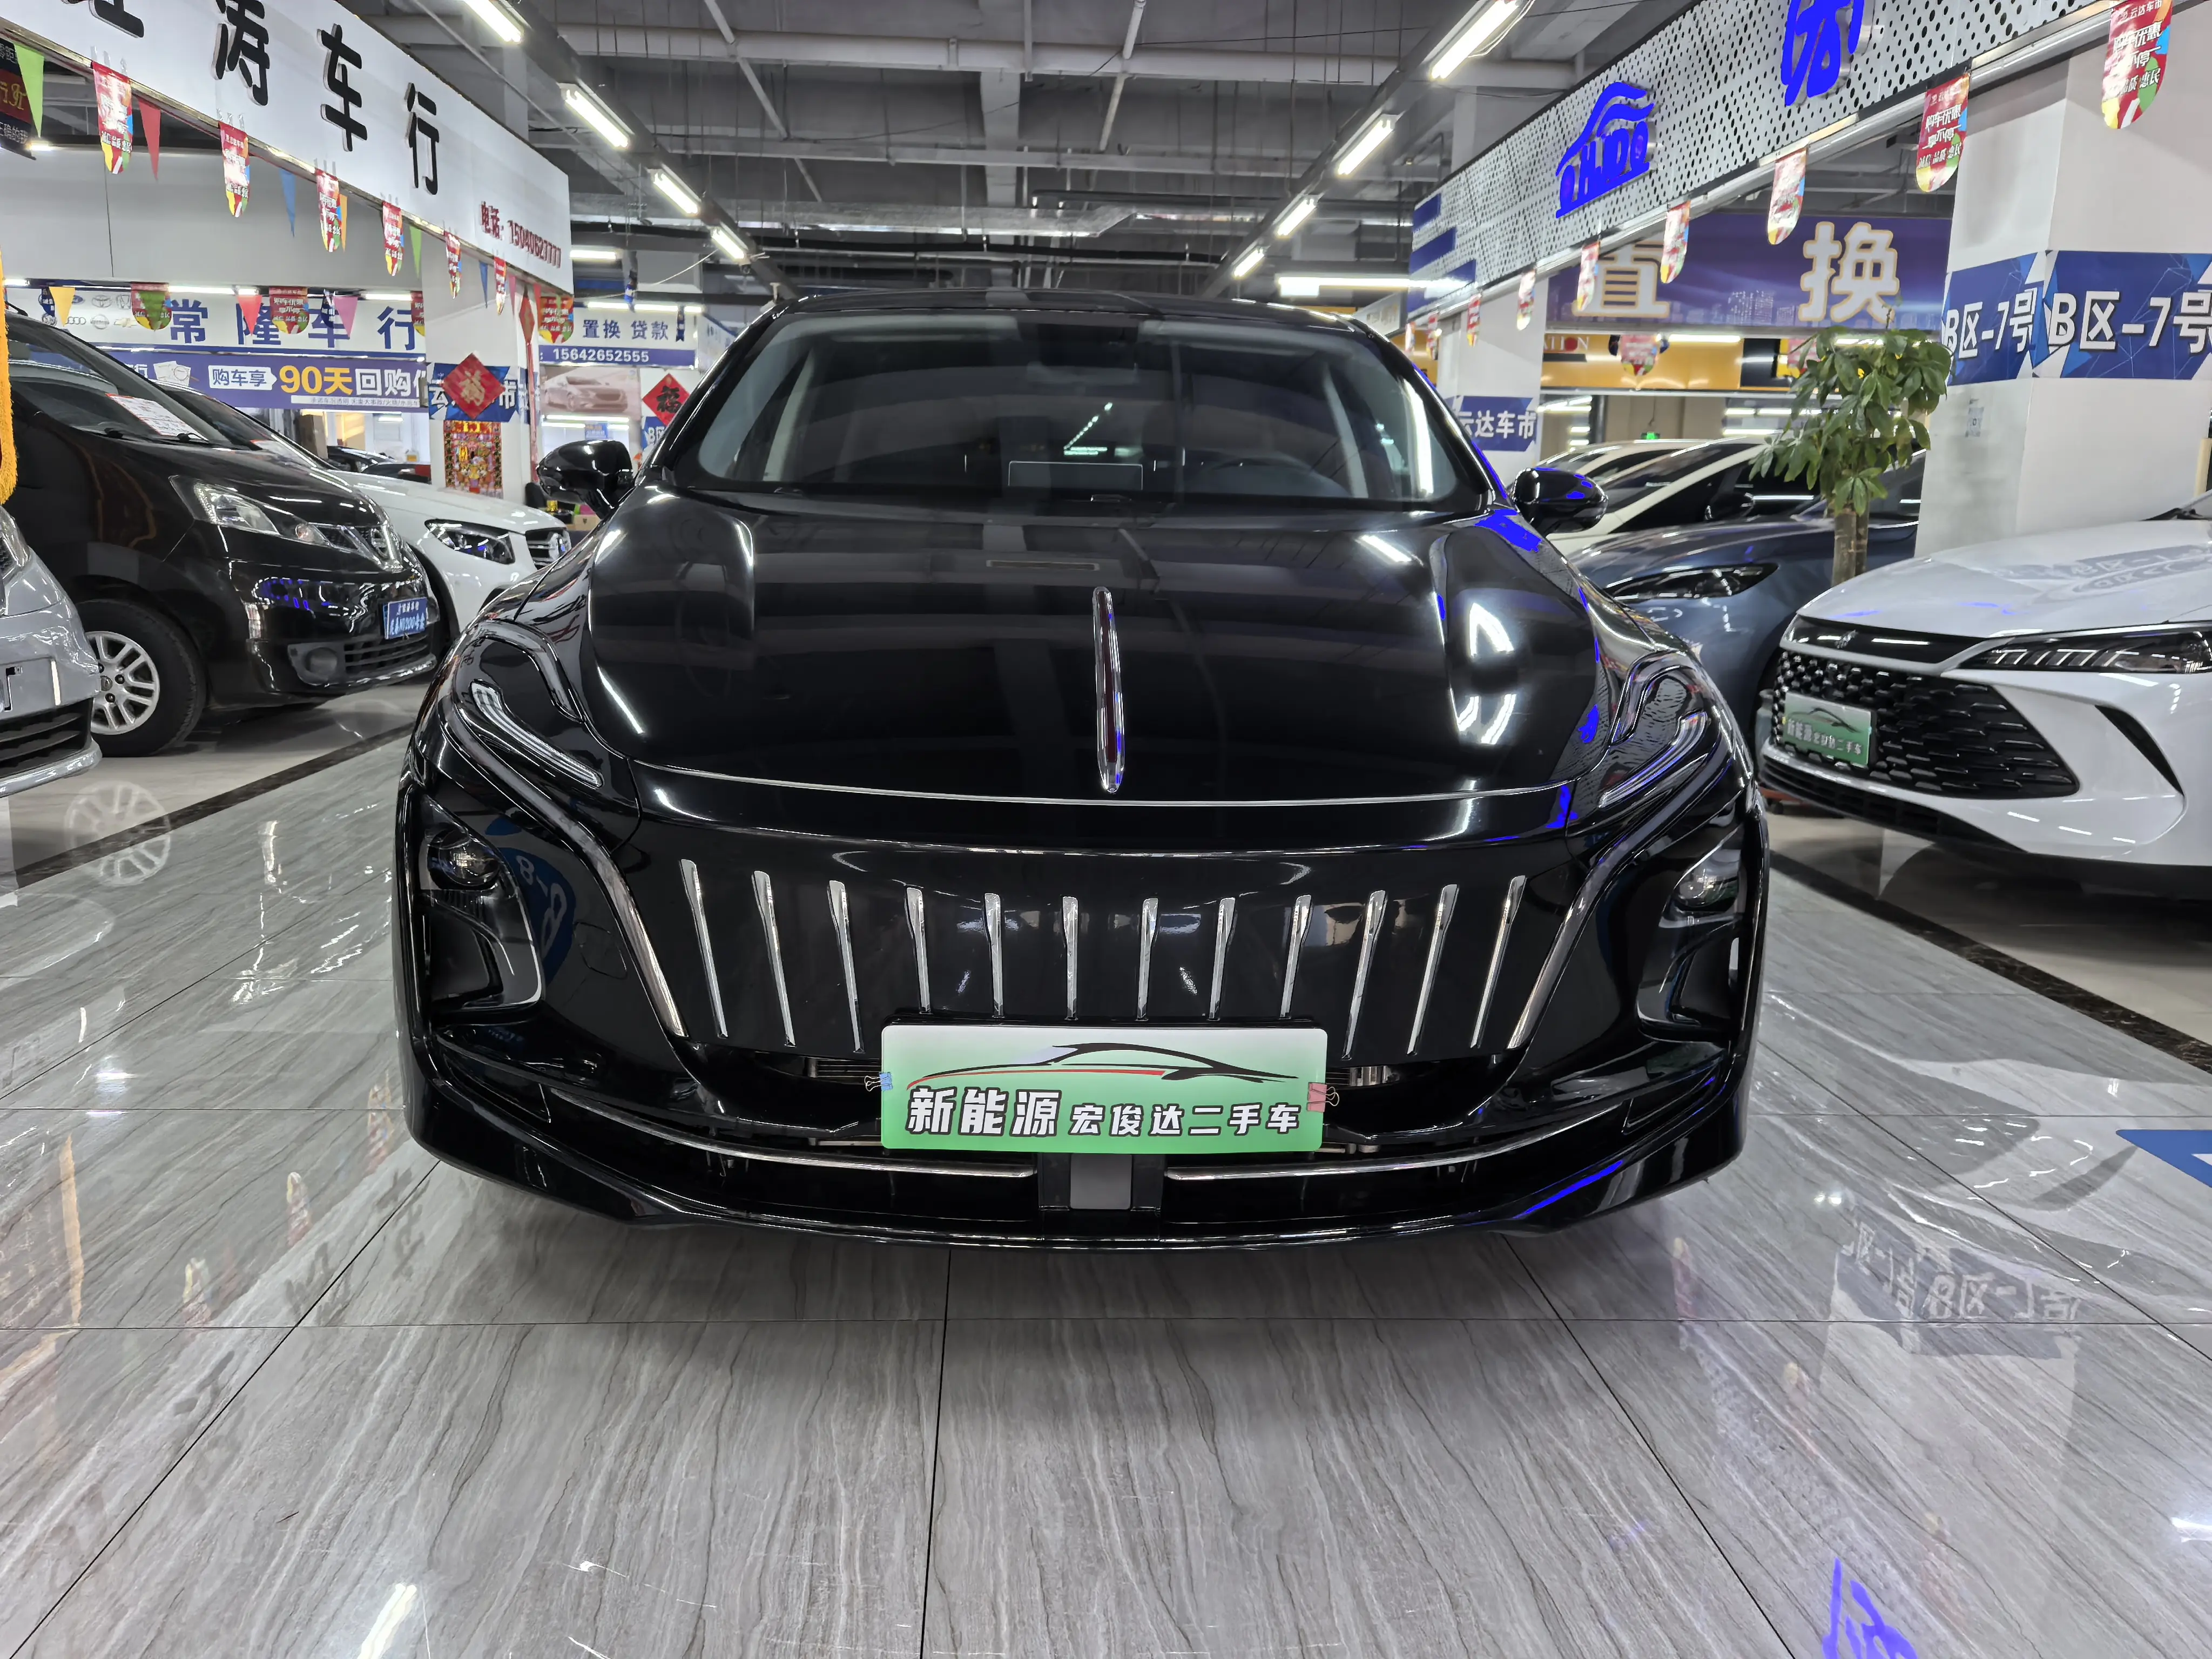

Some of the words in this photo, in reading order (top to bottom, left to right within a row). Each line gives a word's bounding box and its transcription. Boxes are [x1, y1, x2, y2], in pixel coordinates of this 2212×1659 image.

[583, 319, 621, 339] 置换
[631, 320, 669, 341] 贷款
[552, 348, 649, 362] 15642652555
[212, 368, 267, 387] 购车享
[905, 1085, 1062, 1137] 新能源
[1068, 1102, 1303, 1137] 宏俊达二手车
